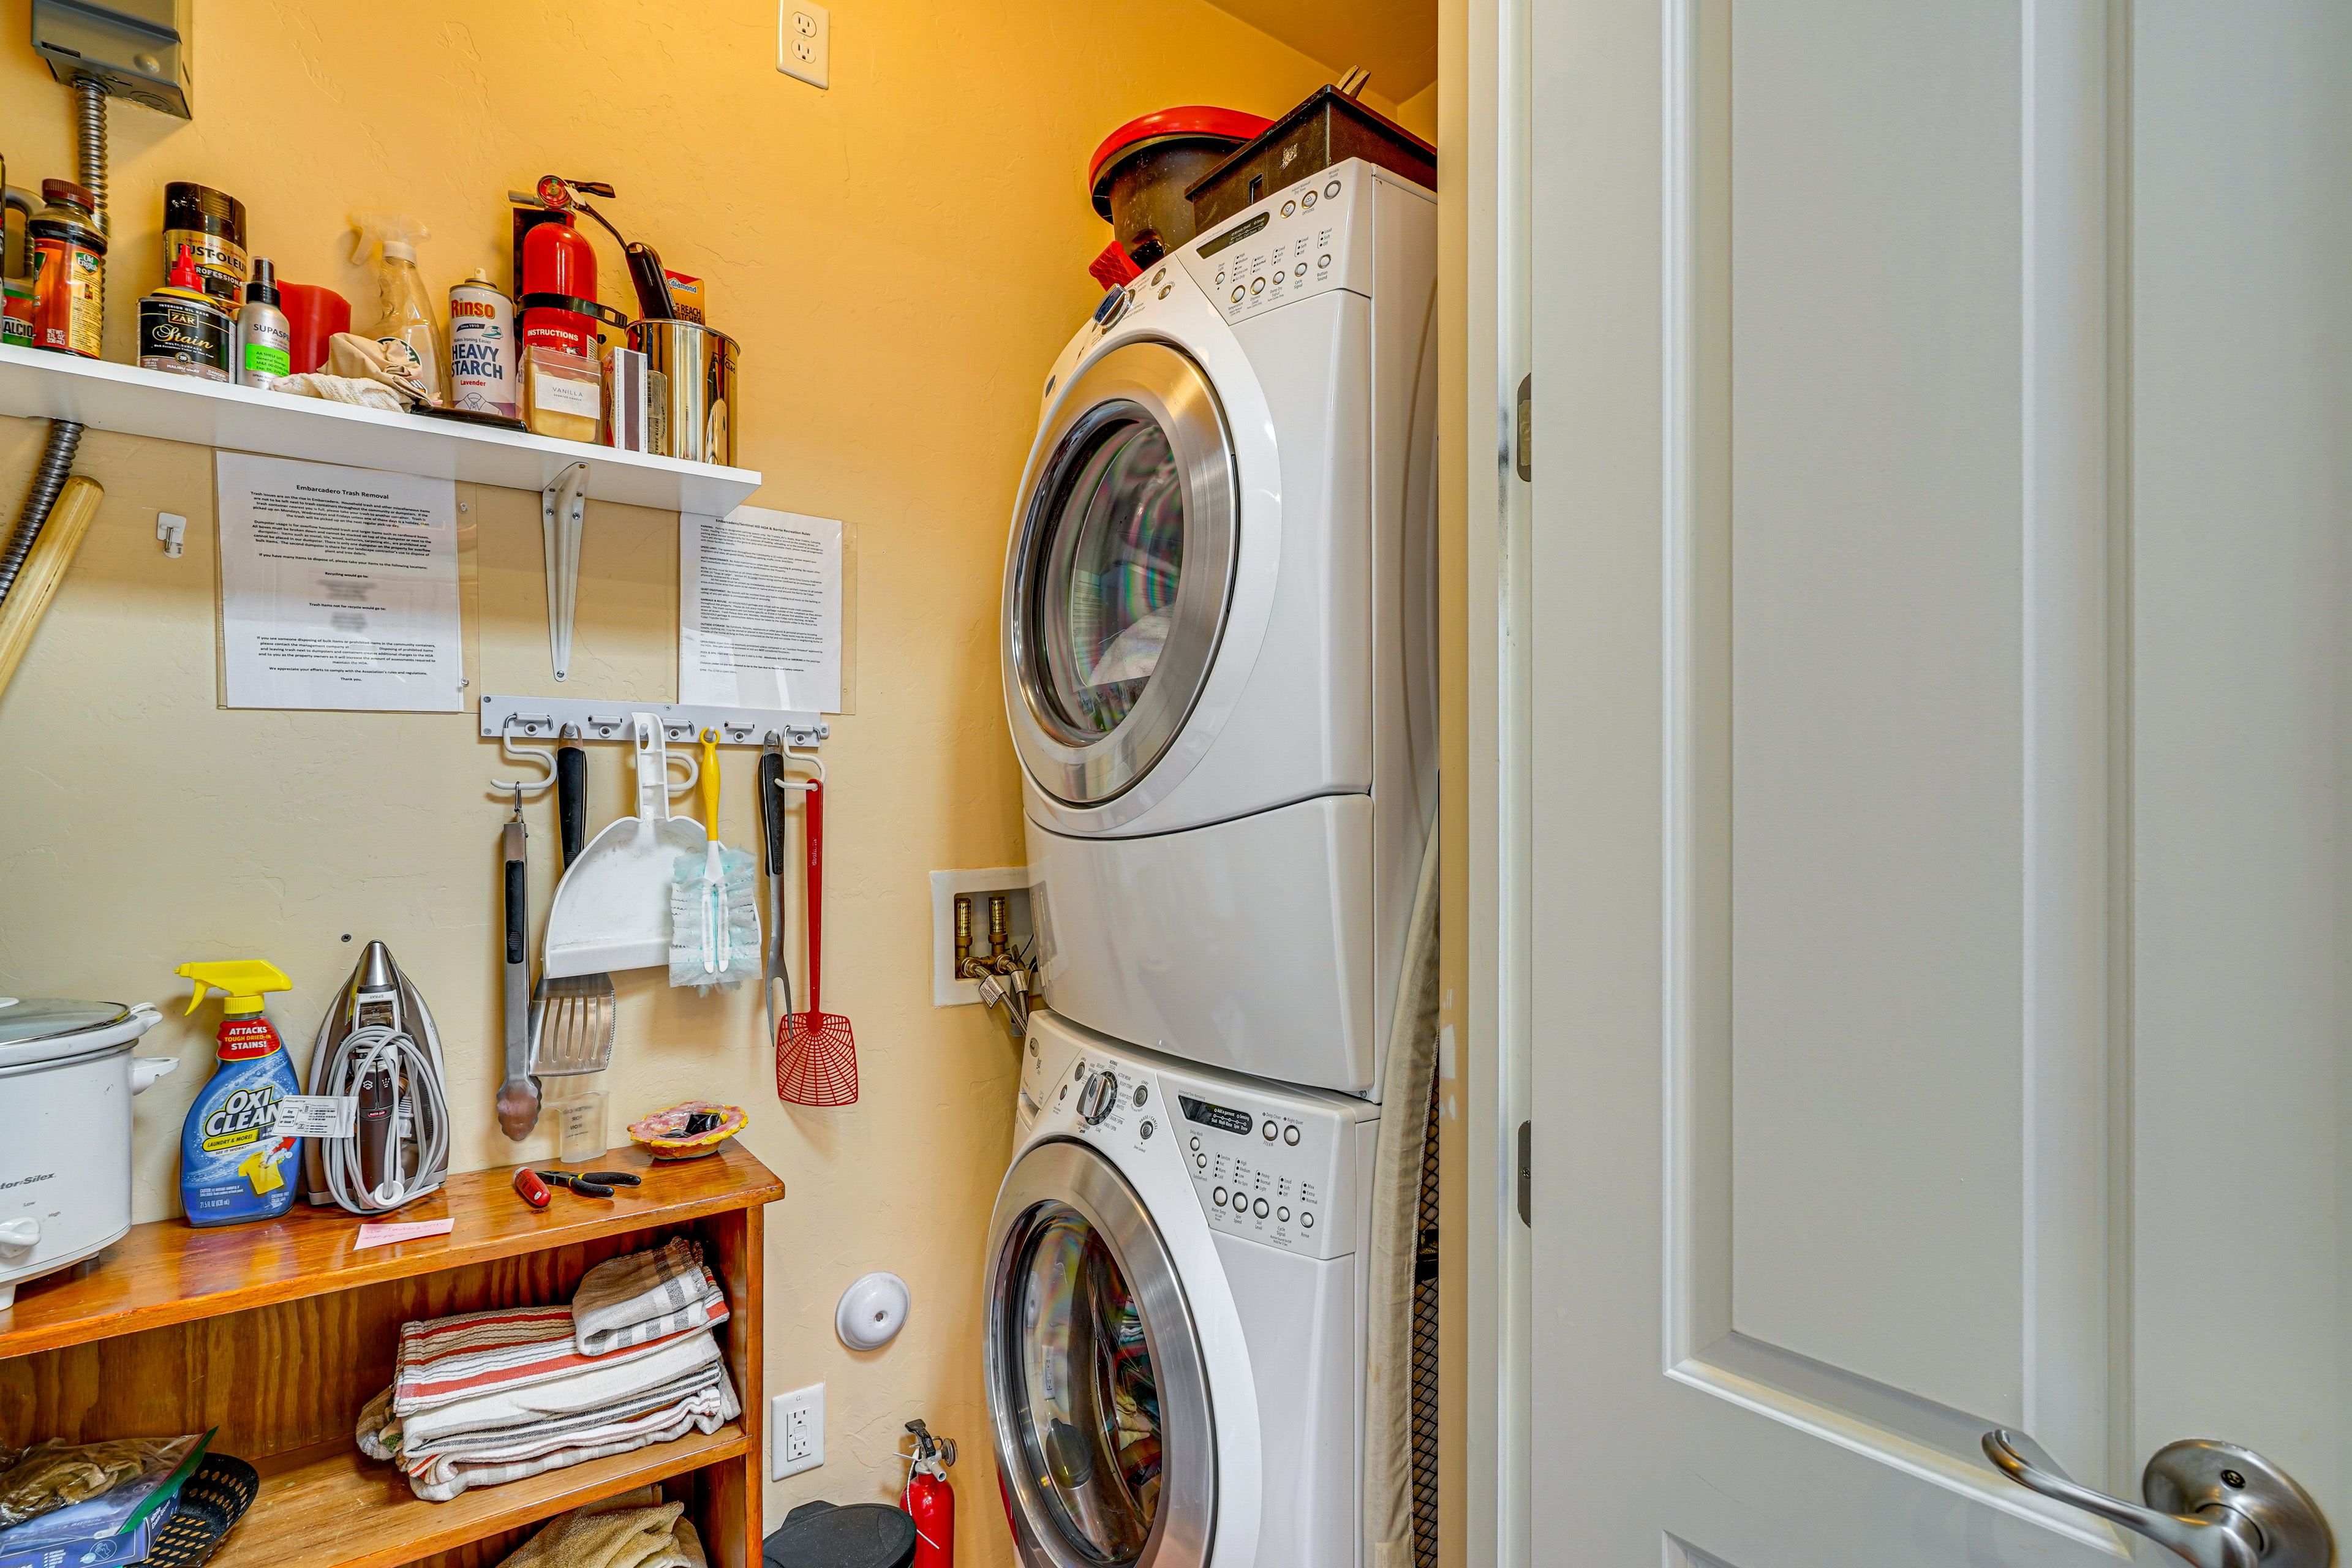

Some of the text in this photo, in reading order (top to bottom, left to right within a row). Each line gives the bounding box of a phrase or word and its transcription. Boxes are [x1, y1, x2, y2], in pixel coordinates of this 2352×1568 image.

[78, 257, 98, 271] English
[83, 254, 94, 263] Old
[671, 280, 697, 293] diamond
[451, 298, 496, 319] Rinso
[681, 304, 701, 318] REACH
[153, 324, 214, 349] Stain
[527, 329, 579, 342] INSTRUCTIONS
[452, 344, 499, 362] HEAVY
[451, 360, 503, 380] STARCH
[552, 387, 583, 397] VANILLA
[296, 484, 341, 494] Embarcadero
[229, 1027, 267, 1035] ATTACKS
[231, 1041, 267, 1050] STAINS!
[225, 1087, 271, 1114] OXI
[206, 1102, 281, 1136] CLEAN
[207, 1138, 230, 1148] LAUNDRY
[236, 1134, 253, 1142] MORE!
